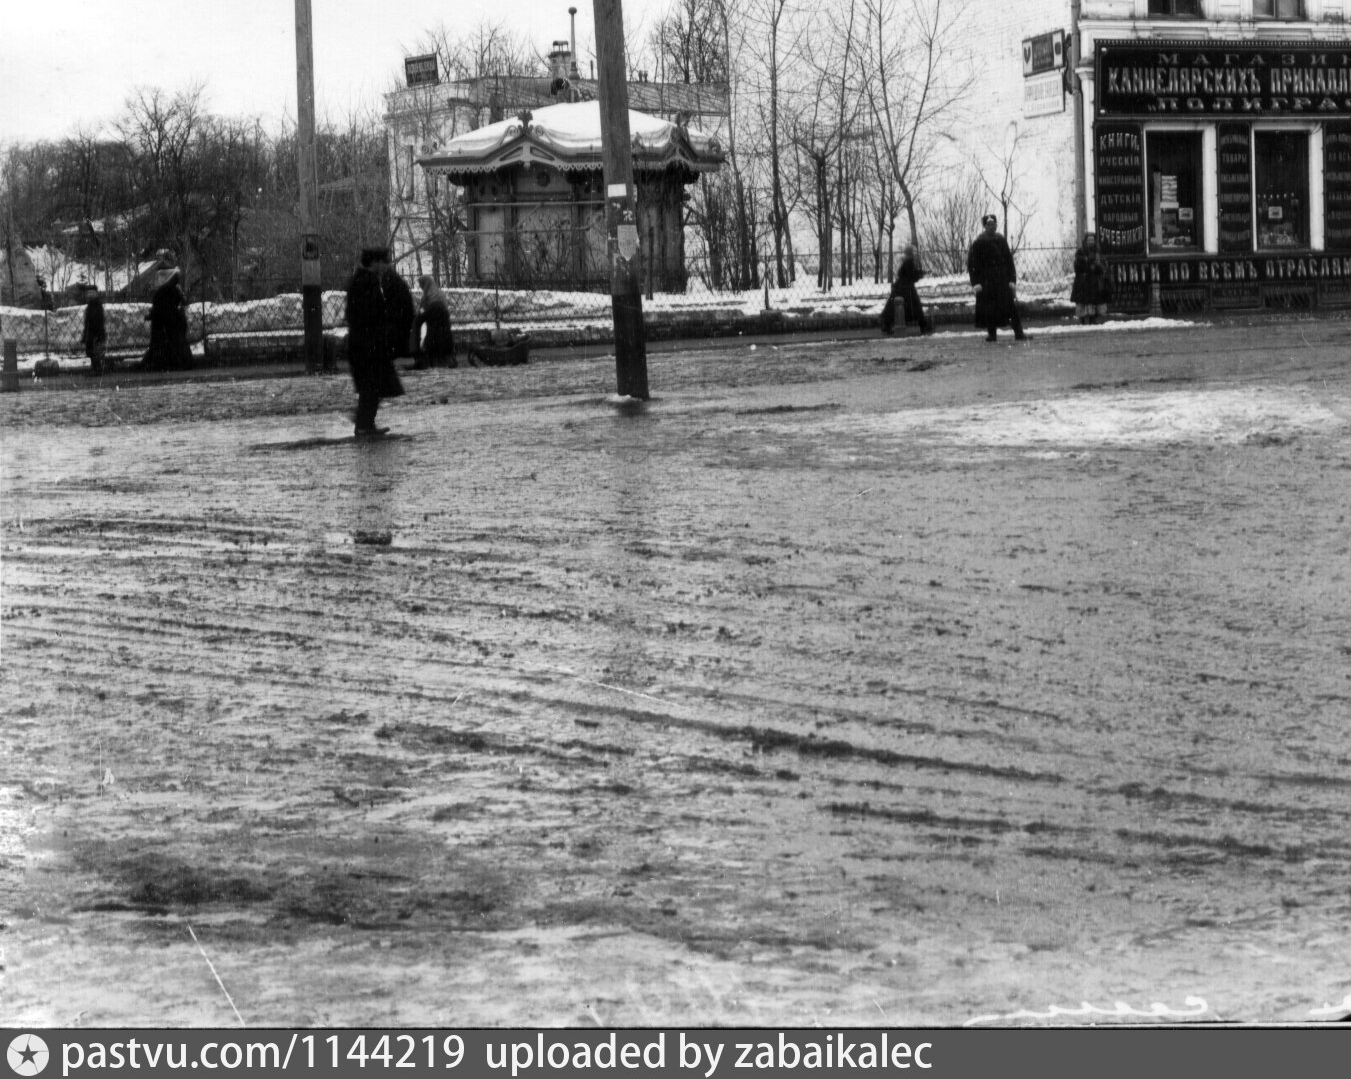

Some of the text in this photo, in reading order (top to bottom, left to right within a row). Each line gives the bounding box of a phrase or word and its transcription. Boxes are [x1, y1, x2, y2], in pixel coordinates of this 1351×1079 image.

[1108, 67, 1261, 95] КАНЦЕЛЯРСКИХЪ
[1099, 225, 1143, 246] УЧЕБНИКИ
[1168, 261, 1190, 282] ПО
